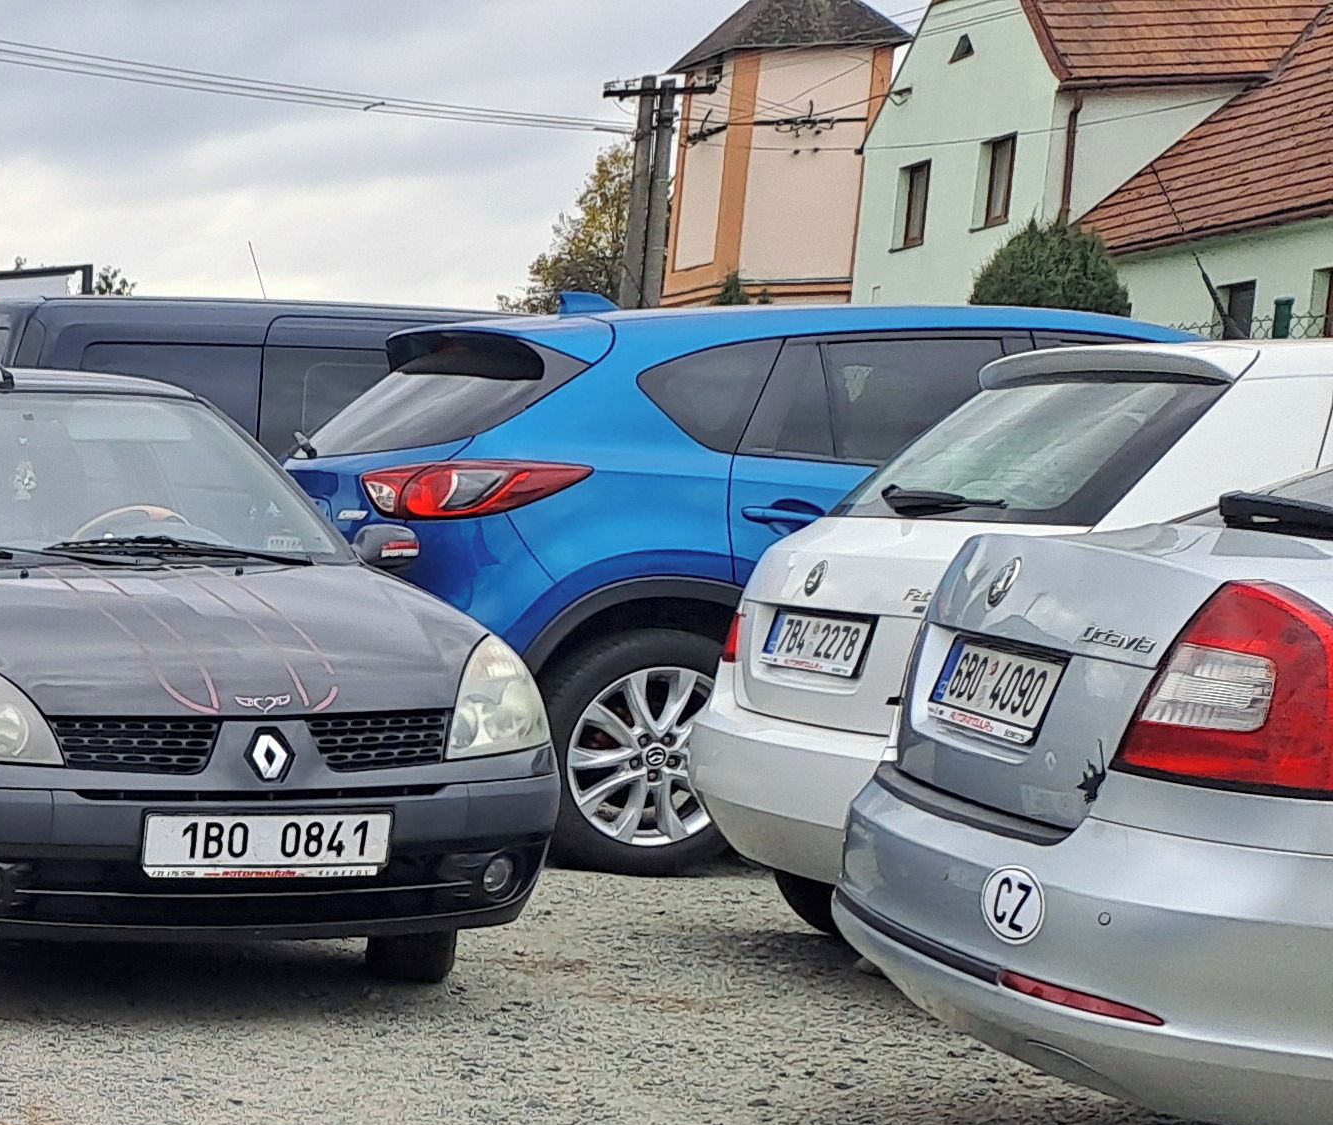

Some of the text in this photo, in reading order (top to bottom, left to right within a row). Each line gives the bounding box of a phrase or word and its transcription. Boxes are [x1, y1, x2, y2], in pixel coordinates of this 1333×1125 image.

[776, 618, 861, 662] 7B4 2278
[949, 651, 1048, 718] 6B0 4090
[182, 820, 369, 859] 1B0 0841
[993, 876, 1033, 934] CZ
